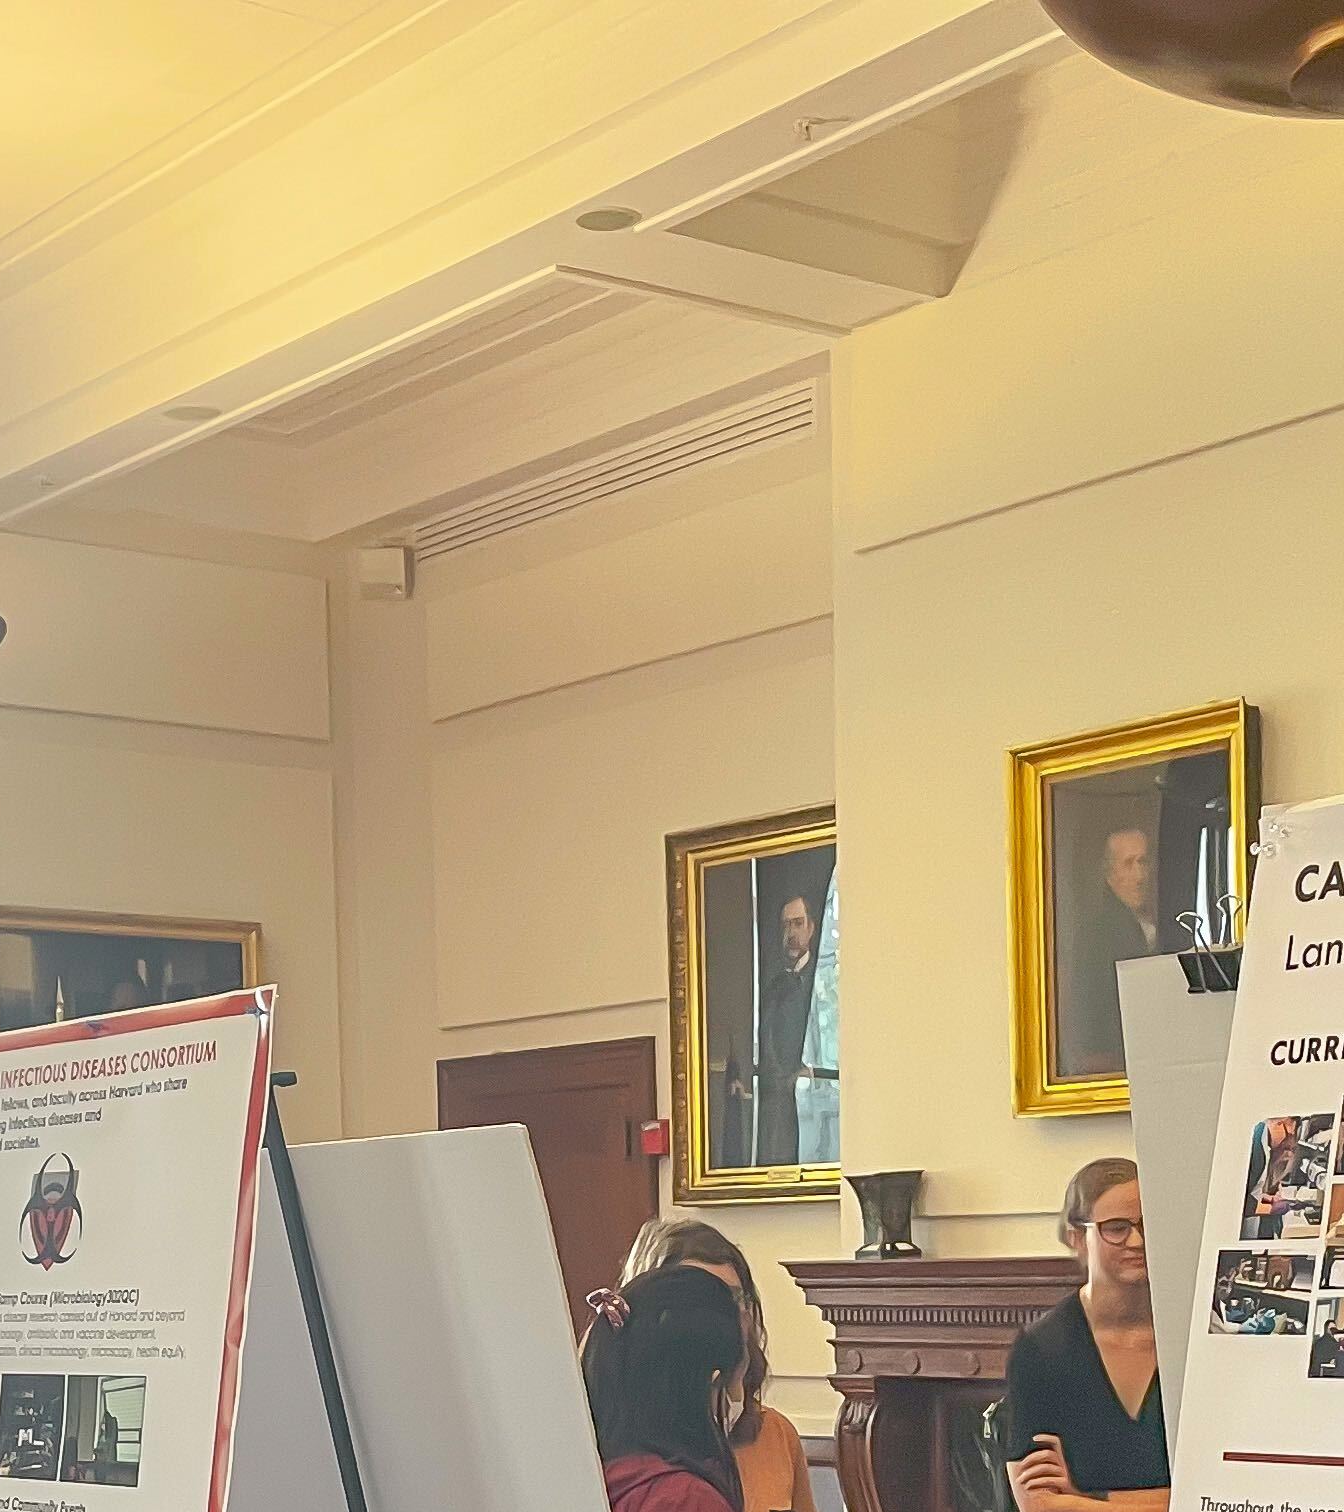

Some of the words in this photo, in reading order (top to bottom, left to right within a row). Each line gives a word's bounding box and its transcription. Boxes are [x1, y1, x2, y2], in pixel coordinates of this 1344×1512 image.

[0, 1061, 67, 1090] INFECTIOUS
[70, 1054, 127, 1081] DISEASES
[130, 1040, 217, 1074] CONSORTIUM
